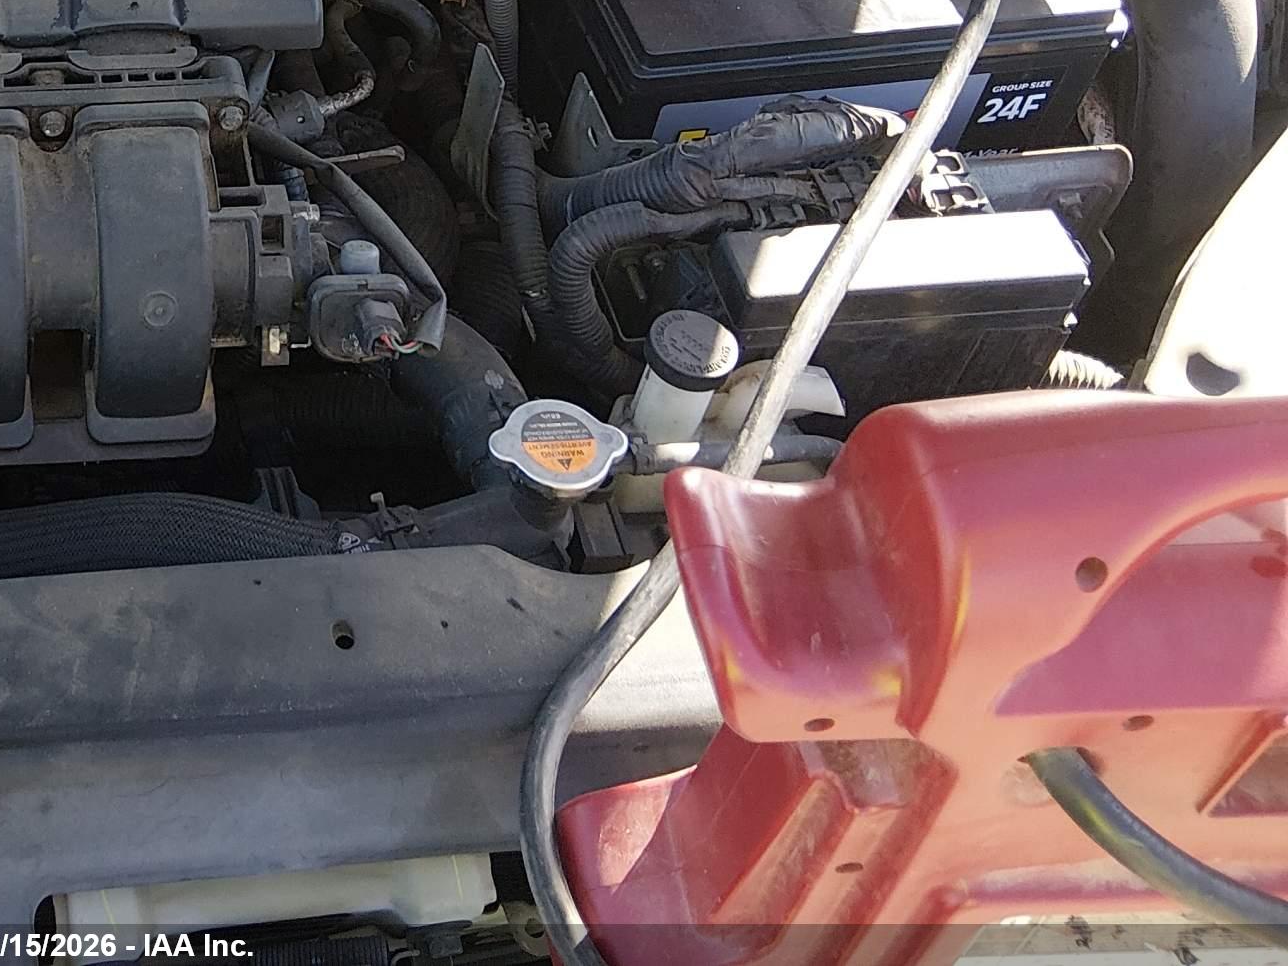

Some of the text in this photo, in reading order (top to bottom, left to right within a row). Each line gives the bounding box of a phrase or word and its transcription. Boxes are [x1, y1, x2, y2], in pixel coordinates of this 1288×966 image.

[992, 80, 1054, 94] GROUP SIZE
[976, 93, 1047, 124] 24F
[528, 441, 592, 450] AVERTISSEMENT
[540, 449, 585, 458] WARNING
